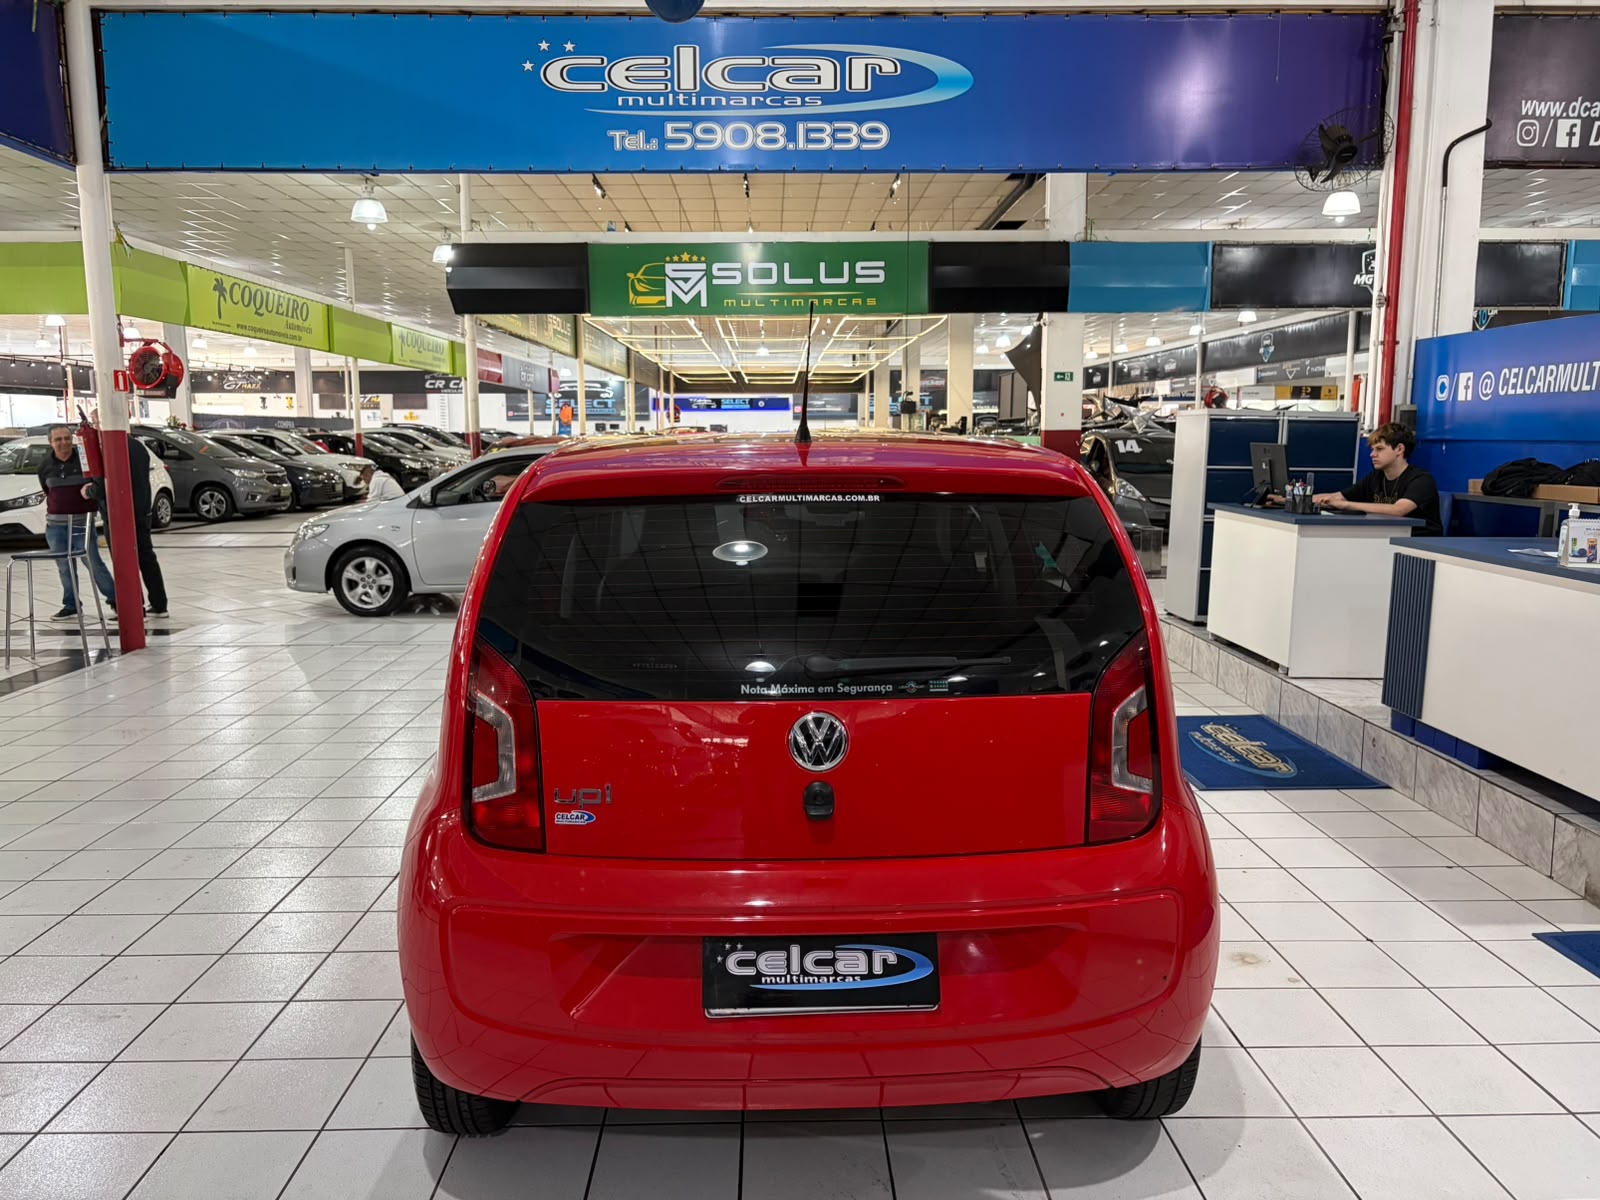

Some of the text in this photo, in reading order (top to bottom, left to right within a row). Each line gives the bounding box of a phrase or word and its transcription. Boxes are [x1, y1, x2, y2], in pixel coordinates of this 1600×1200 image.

[540, 45, 902, 92] celcar
[617, 94, 823, 106] multimarcas
[664, 121, 891, 151] 5908.1339
[711, 261, 886, 285] SOLUS
[228, 281, 310, 322] COQUEIRO
[723, 298, 878, 307] MULTIMARCAS
[1115, 439, 1143, 454] 14
[740, 494, 881, 503] CELCARMULTIMARCAS.COM.BR
[740, 684, 768, 694] Nota
[770, 683, 815, 694] Máxima
[837, 683, 893, 695] Segurança
[554, 784, 612, 809] up!
[725, 944, 898, 976] celcar
[761, 974, 862, 985] multimarcas
